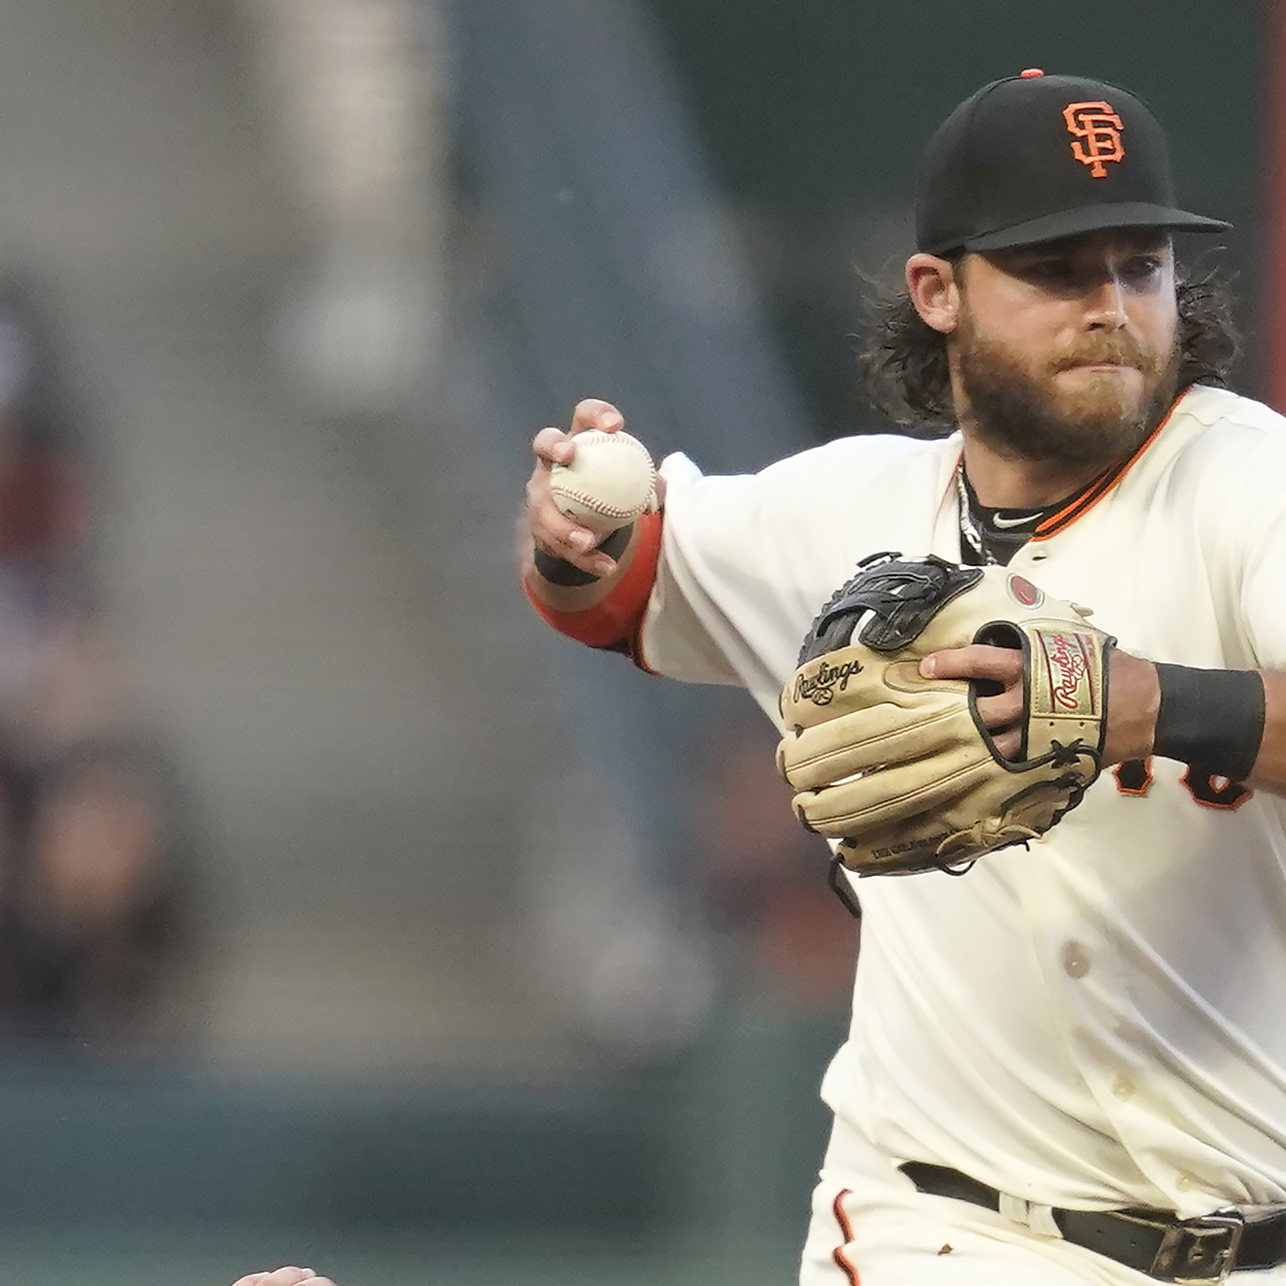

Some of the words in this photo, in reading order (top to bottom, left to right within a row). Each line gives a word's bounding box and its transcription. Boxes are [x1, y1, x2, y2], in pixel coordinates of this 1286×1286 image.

[1063, 101, 1125, 178] SF
[793, 660, 865, 704] Rawlings
[1050, 634, 1079, 709] Rawlings
